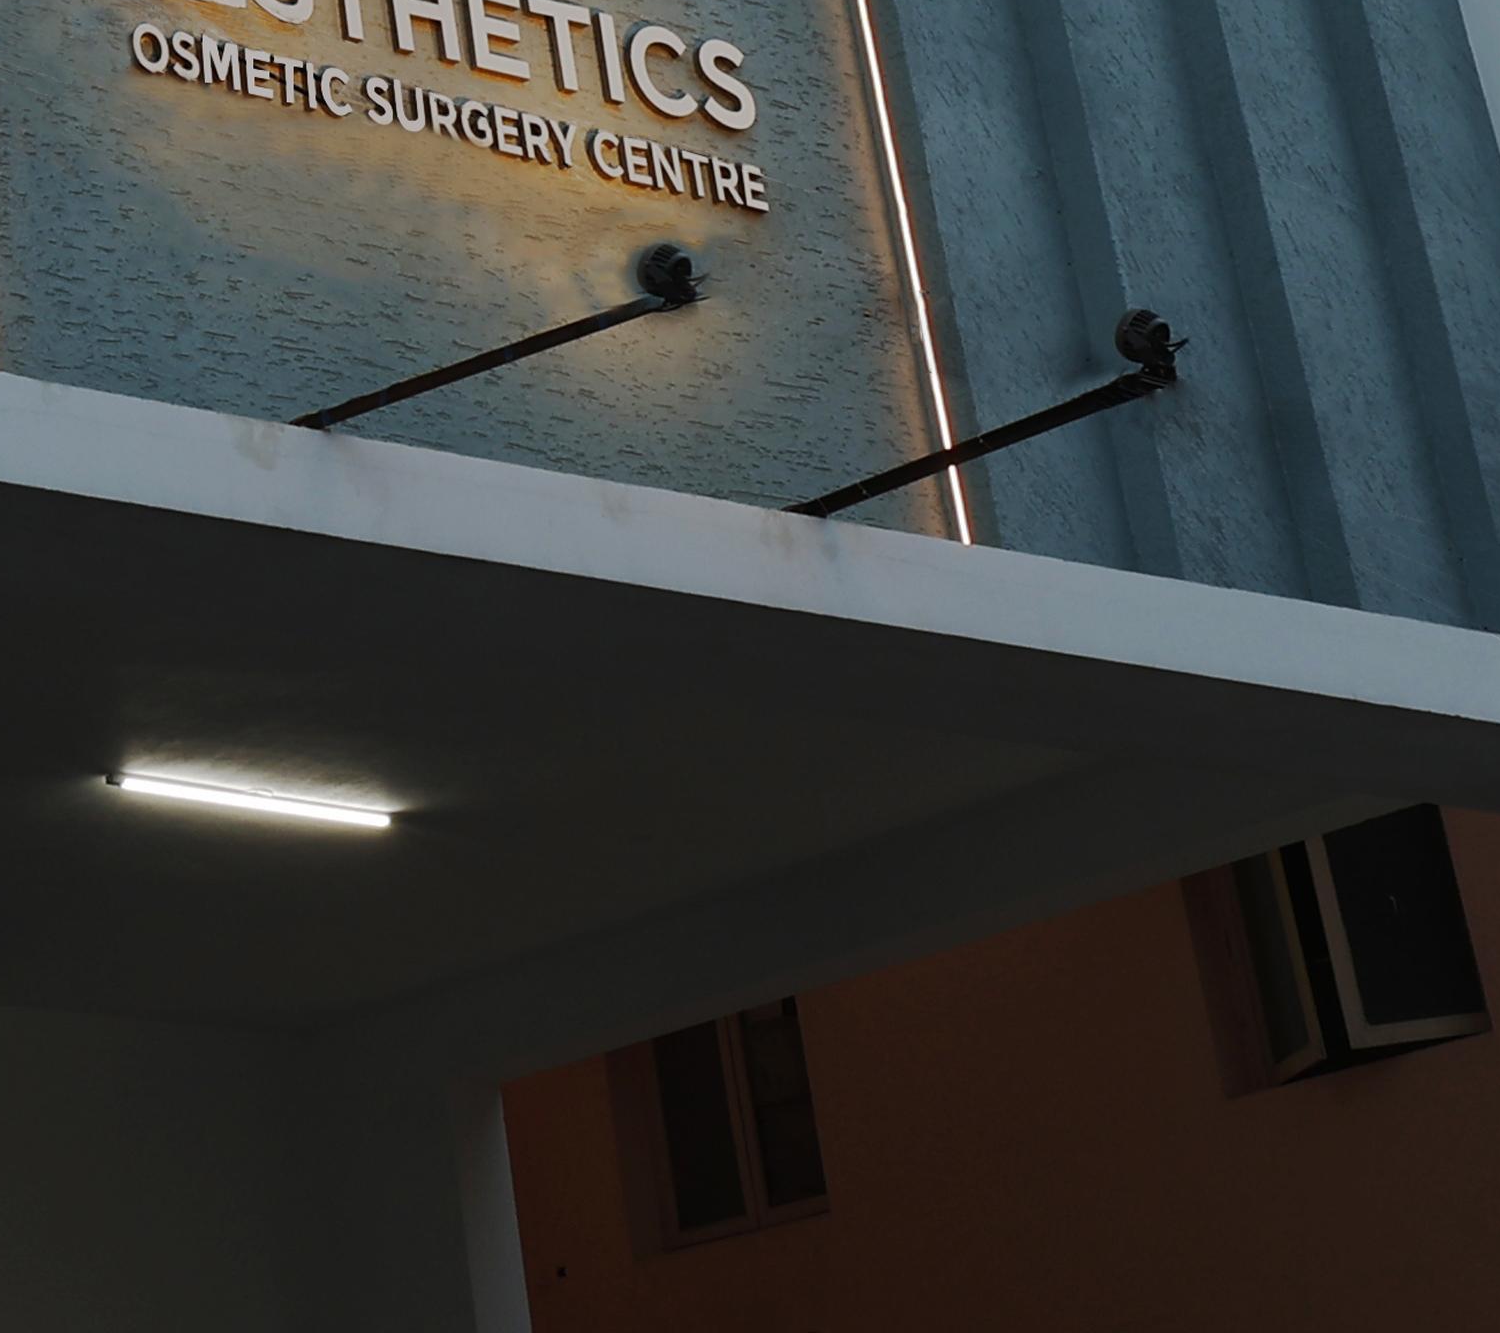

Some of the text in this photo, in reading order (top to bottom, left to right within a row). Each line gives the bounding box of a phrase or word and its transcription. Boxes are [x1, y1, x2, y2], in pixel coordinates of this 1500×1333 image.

[131, 22, 771, 213] OSMETIC SURGERY CENTRE
